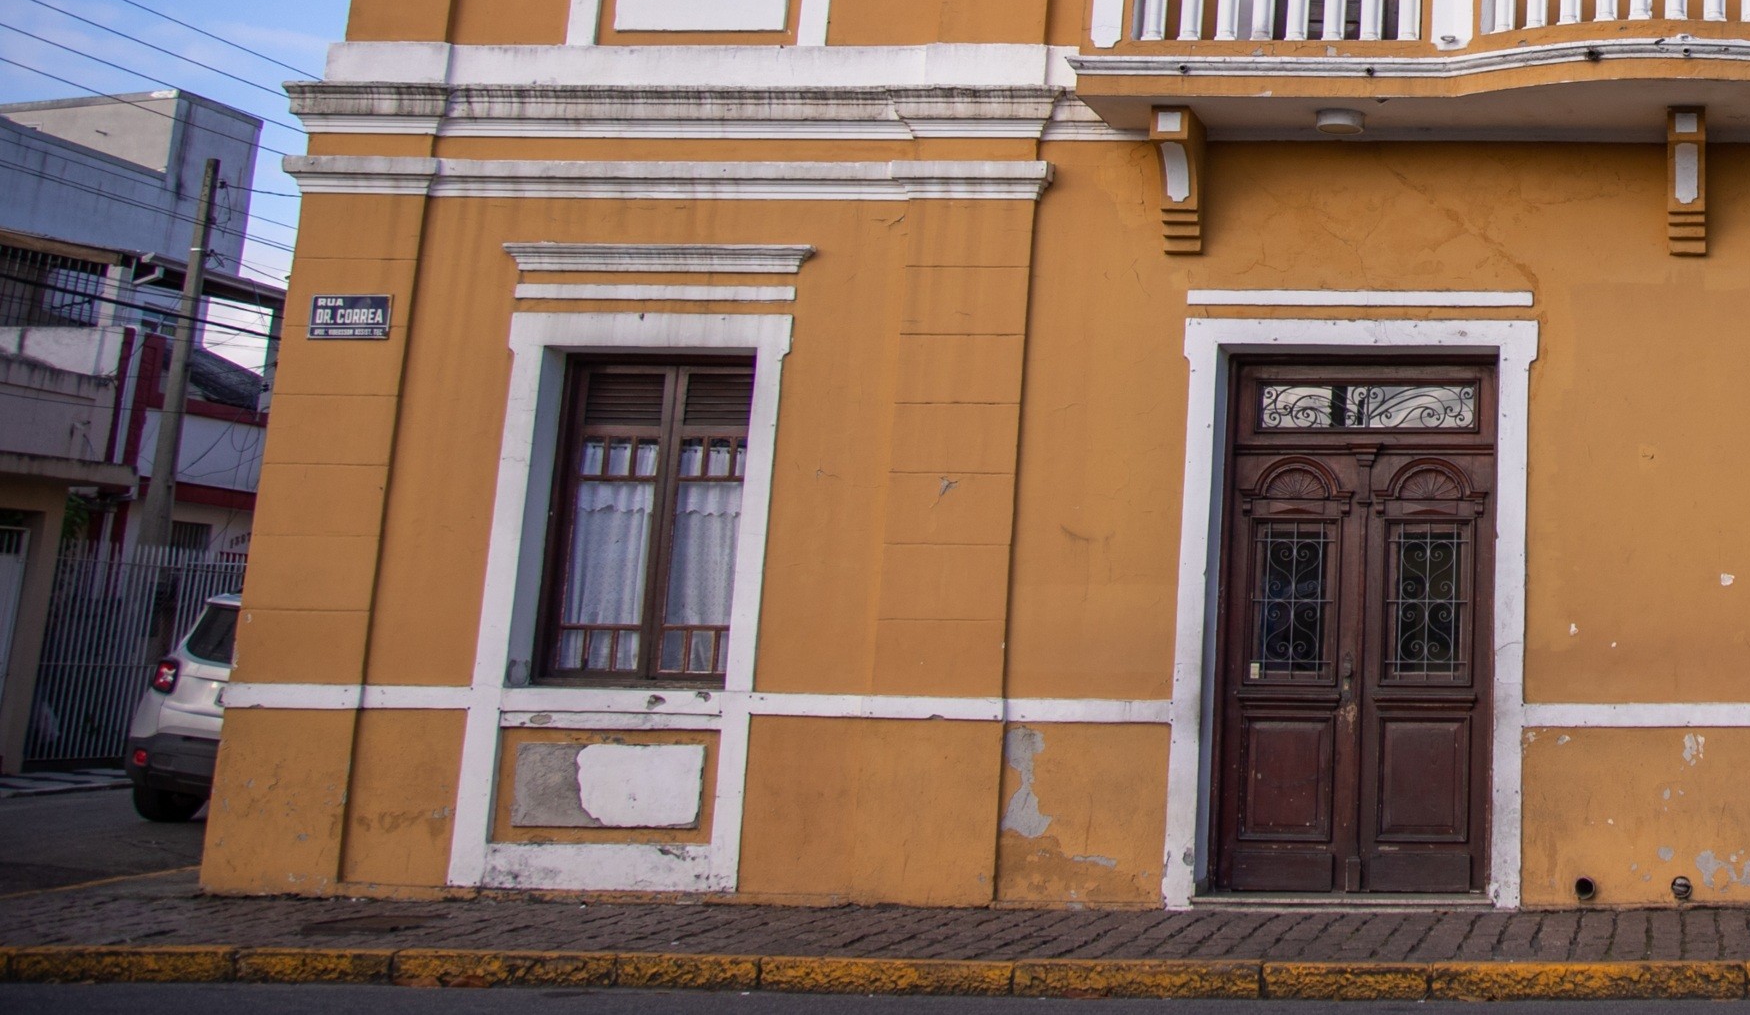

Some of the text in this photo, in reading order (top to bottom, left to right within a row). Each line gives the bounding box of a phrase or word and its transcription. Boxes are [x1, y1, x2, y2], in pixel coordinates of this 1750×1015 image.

[317, 298, 344, 306] RUA
[315, 308, 383, 324] DR. CORREA
